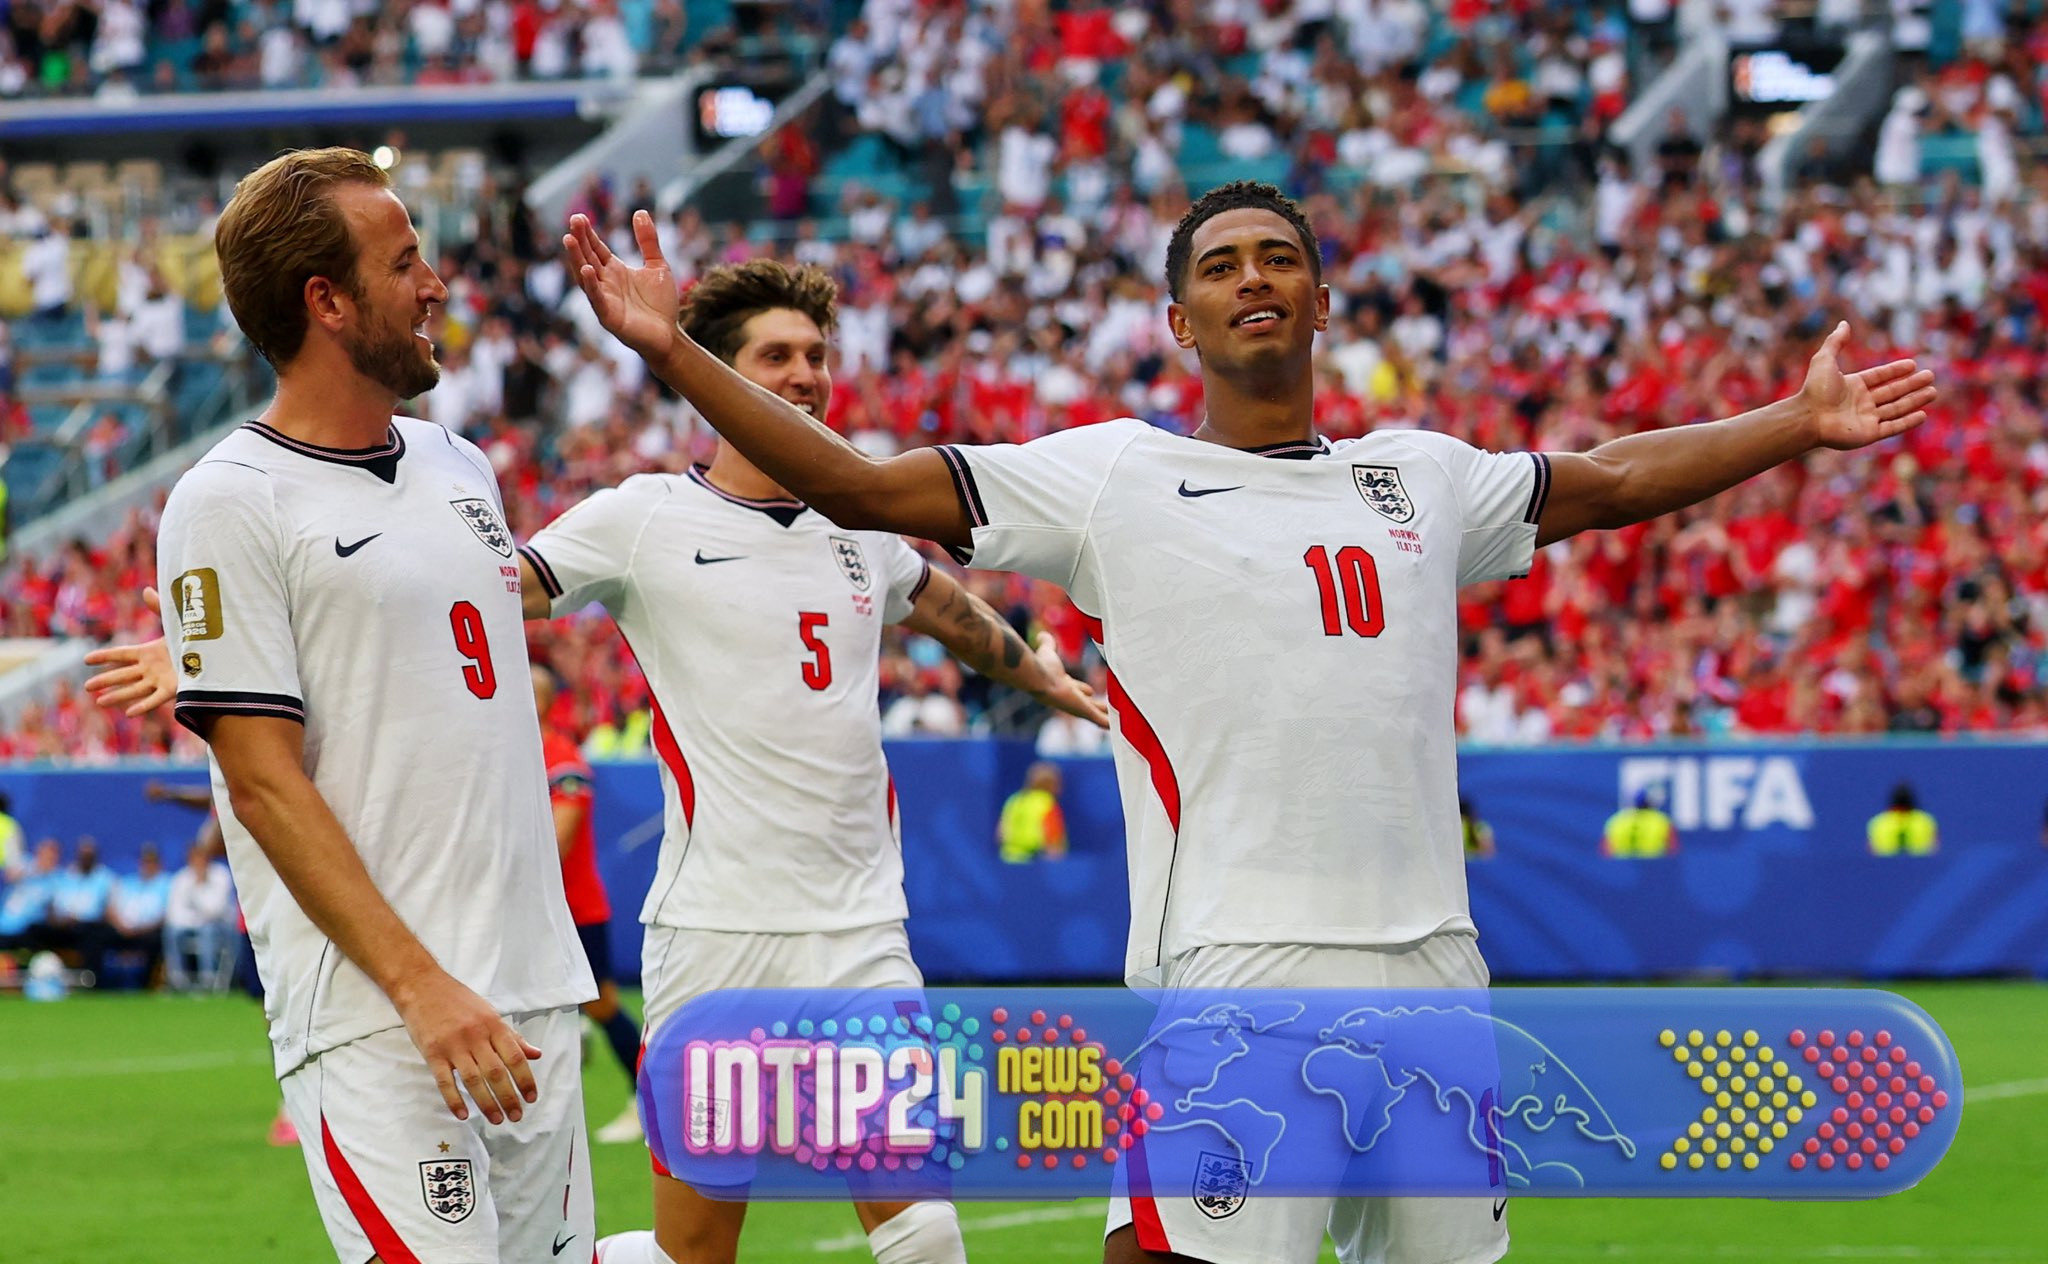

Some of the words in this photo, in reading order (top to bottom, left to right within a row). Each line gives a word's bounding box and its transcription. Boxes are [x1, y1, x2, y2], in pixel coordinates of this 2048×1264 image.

[1388, 528, 1421, 542] NORWAY
[1303, 545, 1386, 638] 10
[449, 600, 498, 700] 9
[799, 611, 832, 691] 5
[1618, 756, 1816, 832] FIFA
